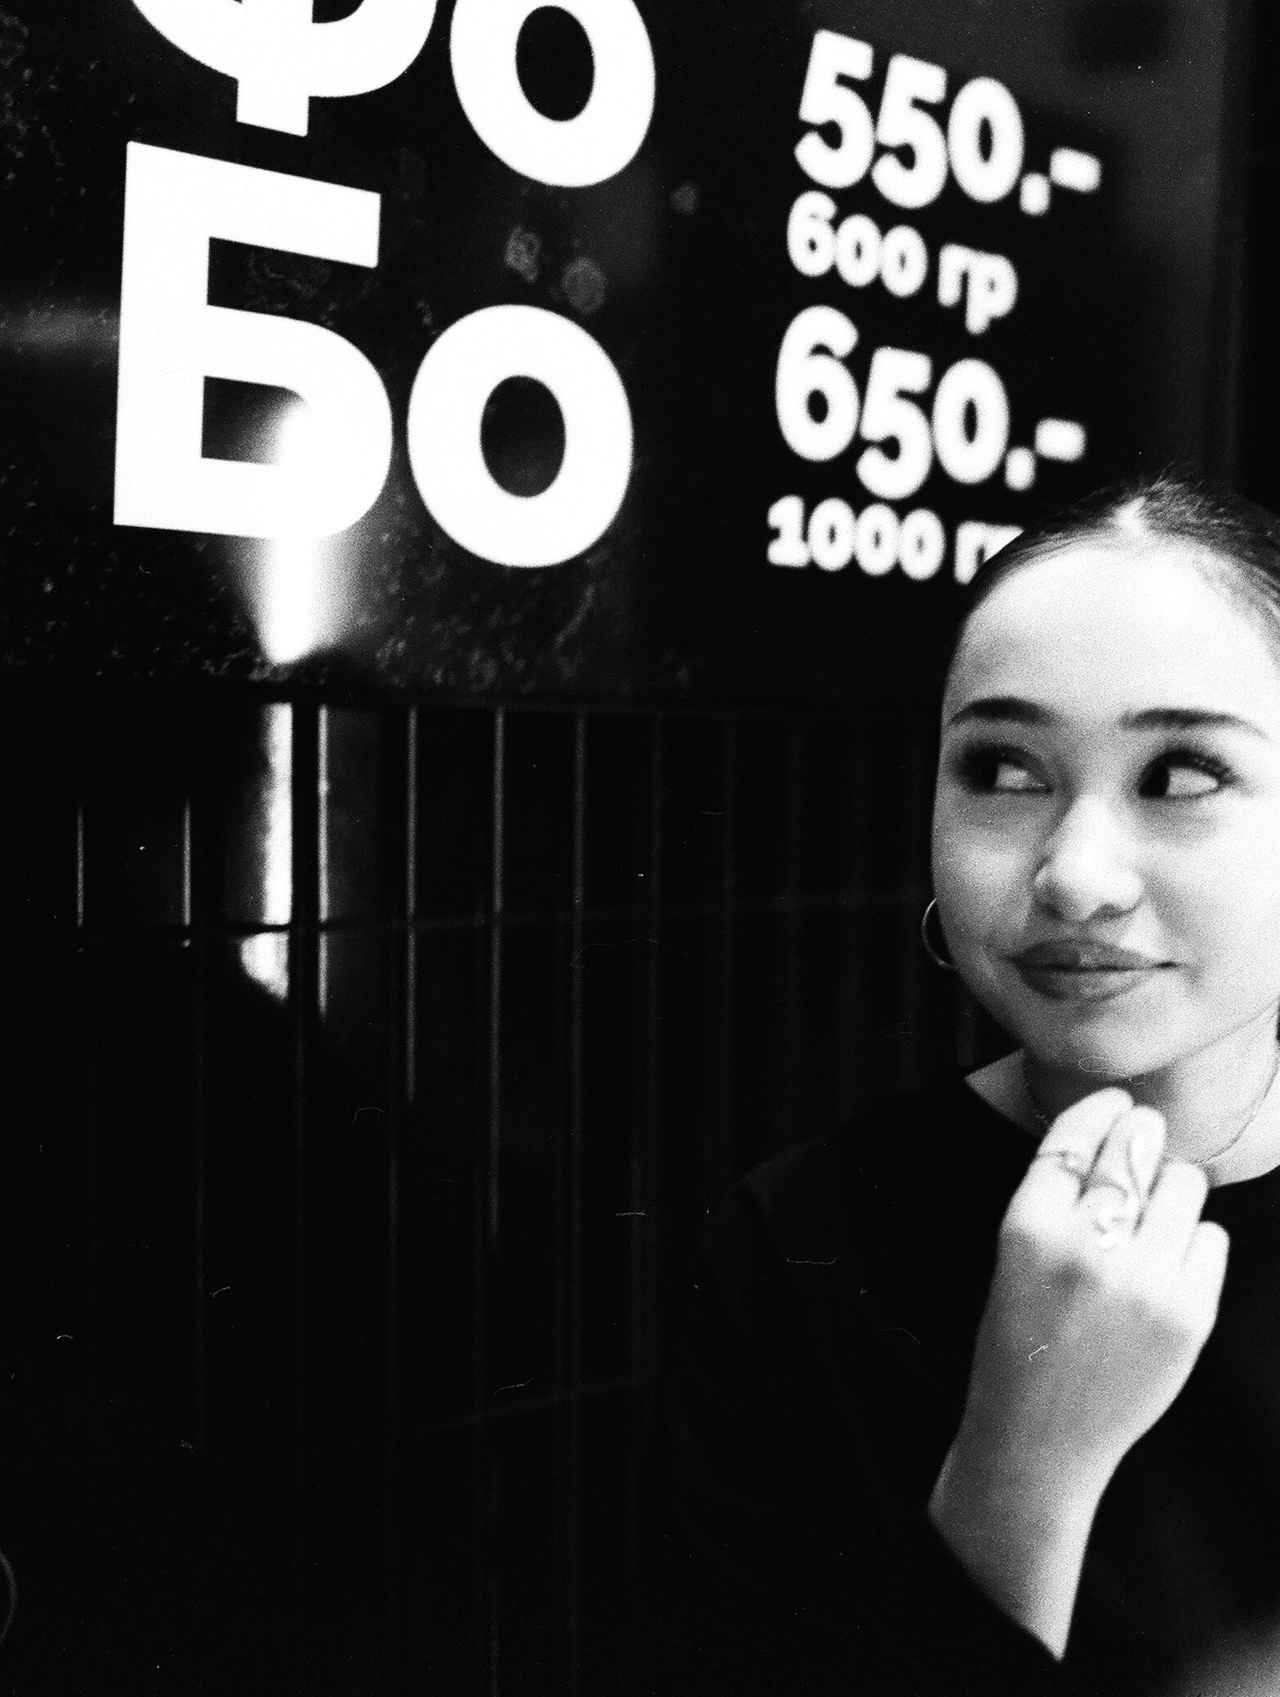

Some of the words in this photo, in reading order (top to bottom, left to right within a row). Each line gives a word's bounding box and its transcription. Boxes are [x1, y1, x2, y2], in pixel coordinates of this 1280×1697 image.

[786, 190, 928, 297] 600
[937, 243, 1019, 335] гр
[113, 140, 634, 568] Бо
[767, 495, 945, 581] 1000
